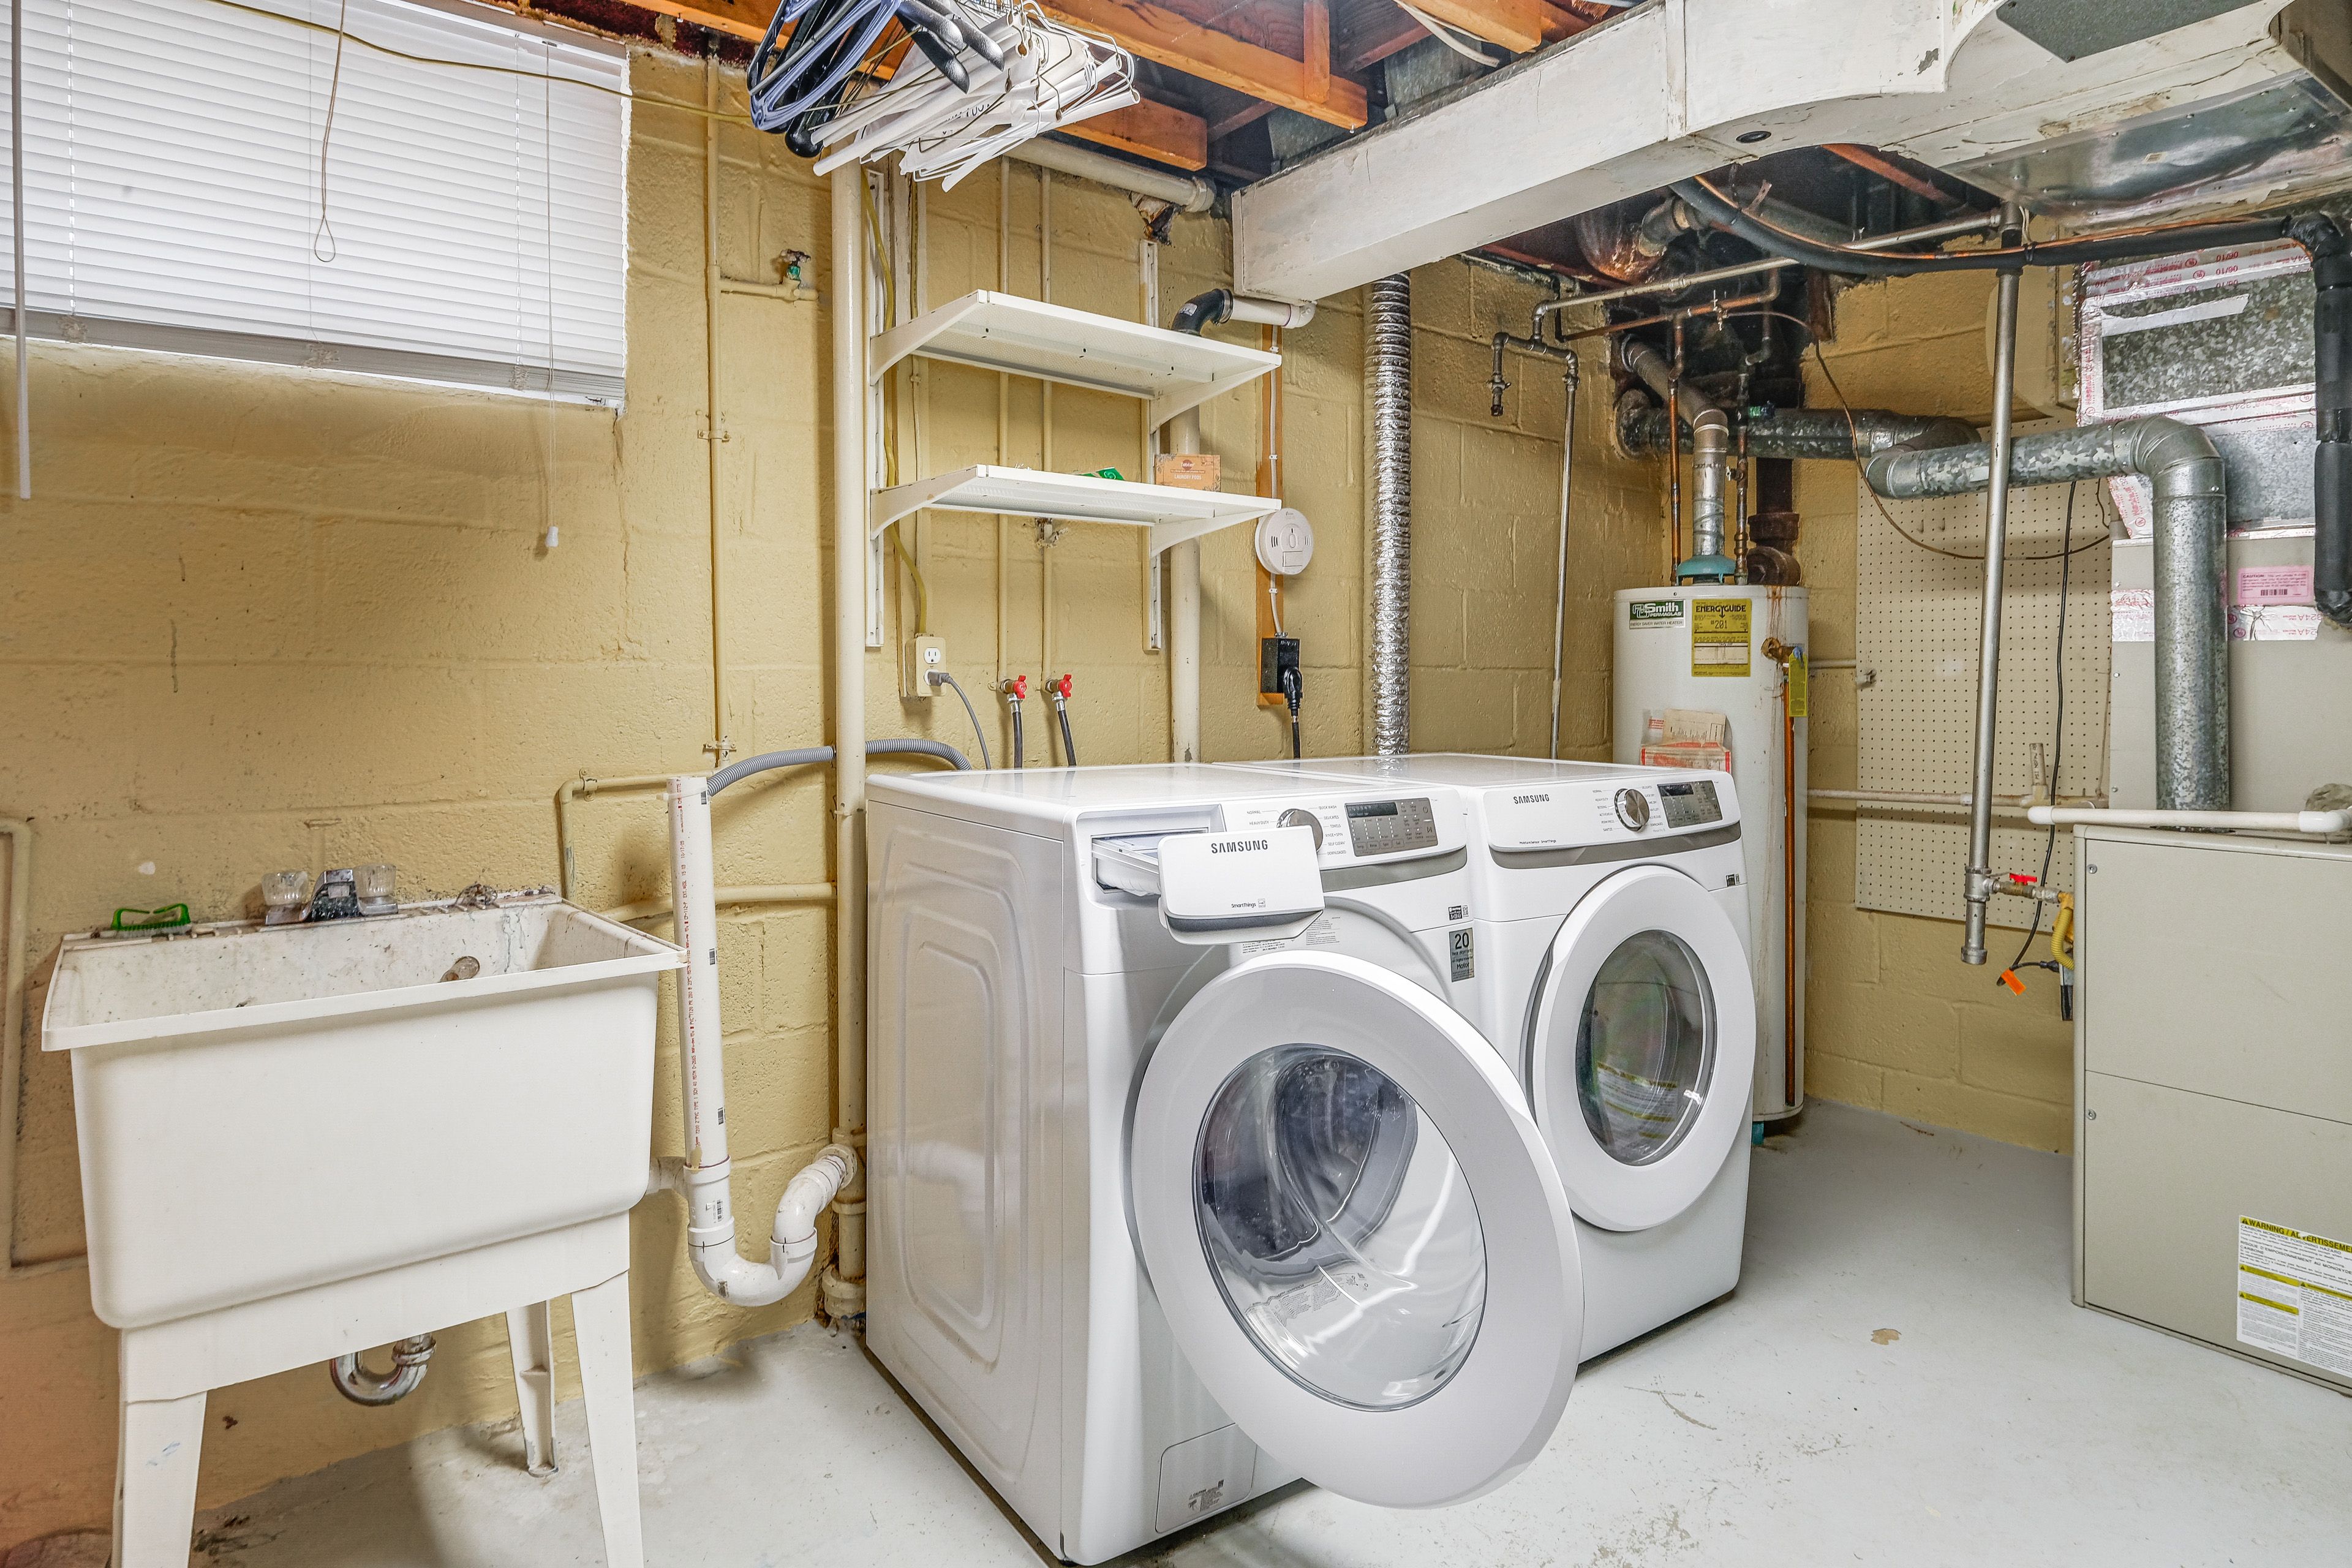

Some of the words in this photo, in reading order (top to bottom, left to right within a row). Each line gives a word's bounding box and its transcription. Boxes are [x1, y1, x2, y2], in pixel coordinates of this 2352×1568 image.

[1644, 602, 1679, 613] Smith
[1513, 794, 1550, 804] SAMSUNG
[1211, 839, 1268, 854] SAMSUNG
[1454, 932, 1469, 949] 20
[2248, 1219, 2284, 1234] WARNING
